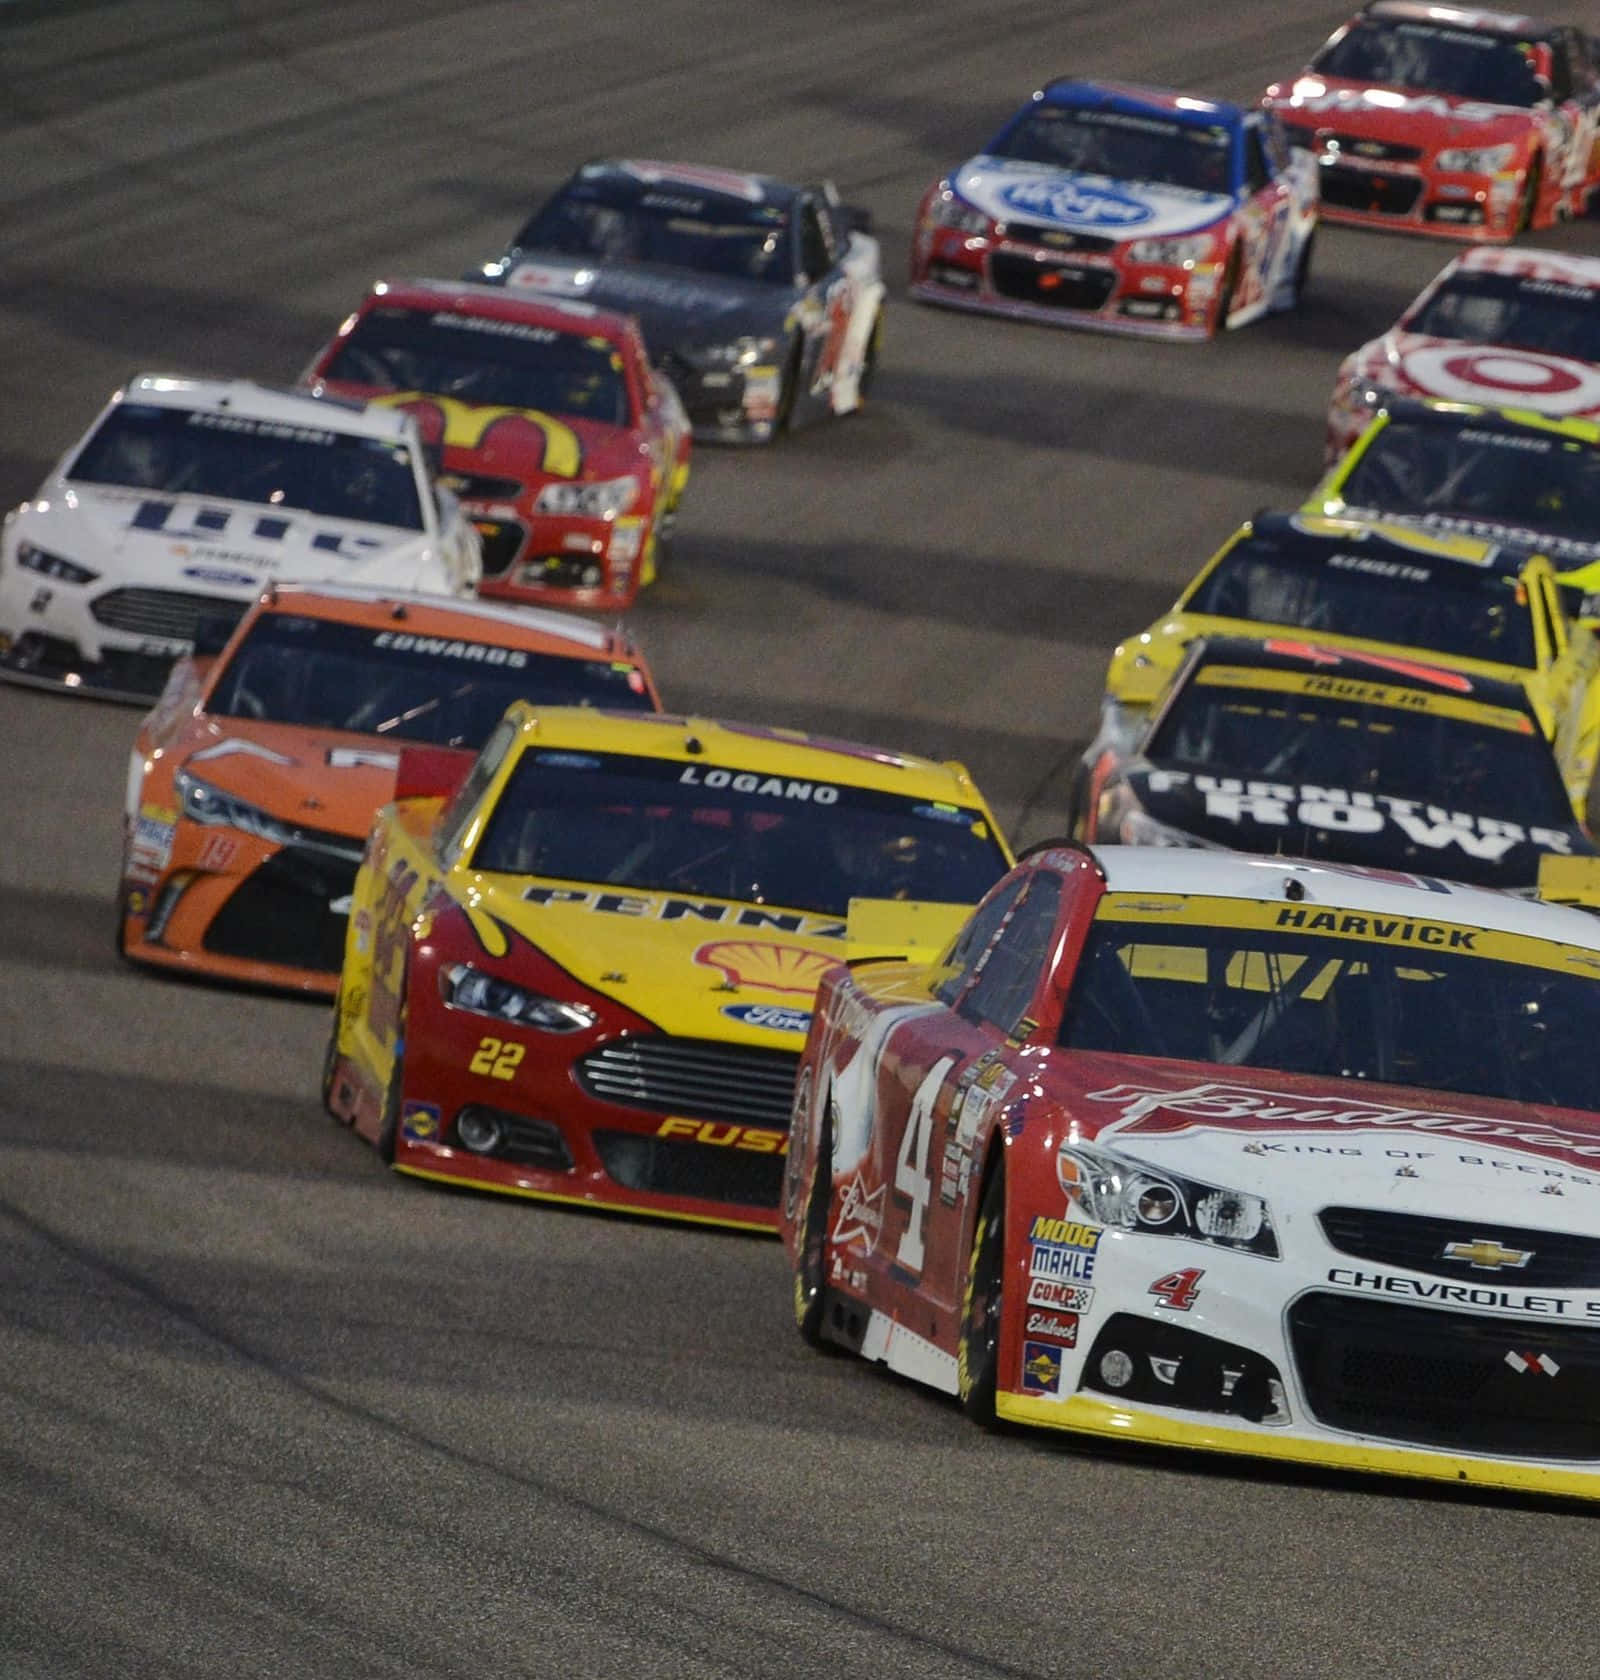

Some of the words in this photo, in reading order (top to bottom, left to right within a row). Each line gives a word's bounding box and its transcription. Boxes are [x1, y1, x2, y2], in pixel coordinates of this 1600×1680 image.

[1327, 554, 1432, 582] KENSETH
[373, 630, 529, 669] EDWARDS
[679, 767, 840, 805] LOGANO
[1149, 770, 1573, 855] FURNITURE
[1206, 794, 1517, 864] ROW
[1276, 906, 1477, 951] HARVICK
[466, 1036, 527, 1082] 22
[895, 1055, 956, 1272] 4
[1262, 1143, 1362, 1156] KING
[1385, 1149, 1436, 1160] OF
[1032, 1215, 1102, 1249] MOOG
[1032, 1247, 1095, 1281] MAHLE
[1146, 1267, 1208, 1312] 4
[1328, 1268, 1573, 1315] CHEVROLET
